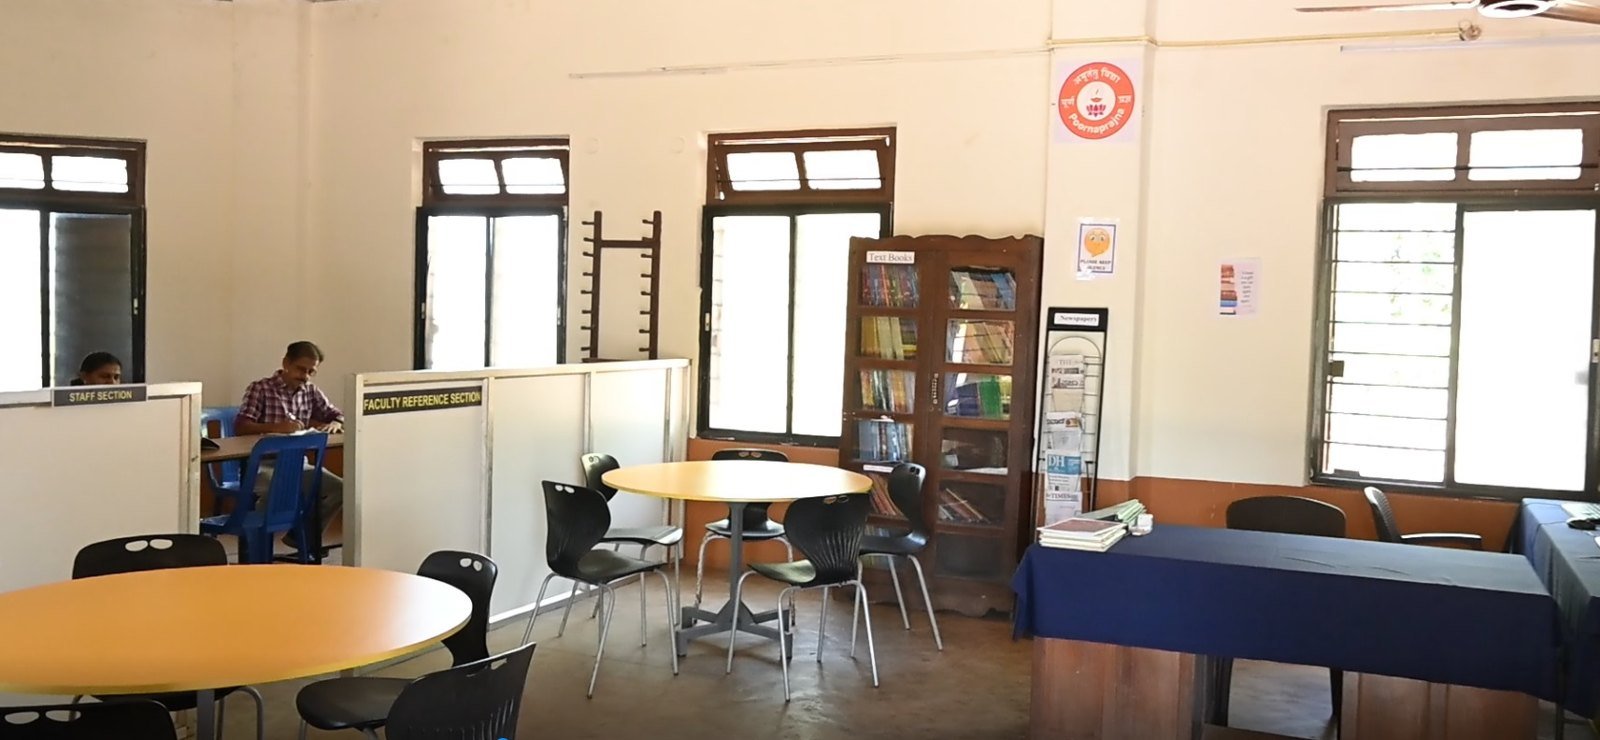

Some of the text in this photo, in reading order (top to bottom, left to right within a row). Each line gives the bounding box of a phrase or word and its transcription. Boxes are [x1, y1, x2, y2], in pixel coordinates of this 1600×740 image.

[1068, 108, 1125, 134] Poornaprajna
[869, 252, 913, 262] Text Books
[69, 390, 132, 402] STAFF SECTION
[363, 391, 481, 410] FACULTY REFERENCE SECTION
[1048, 455, 1065, 467] DH
